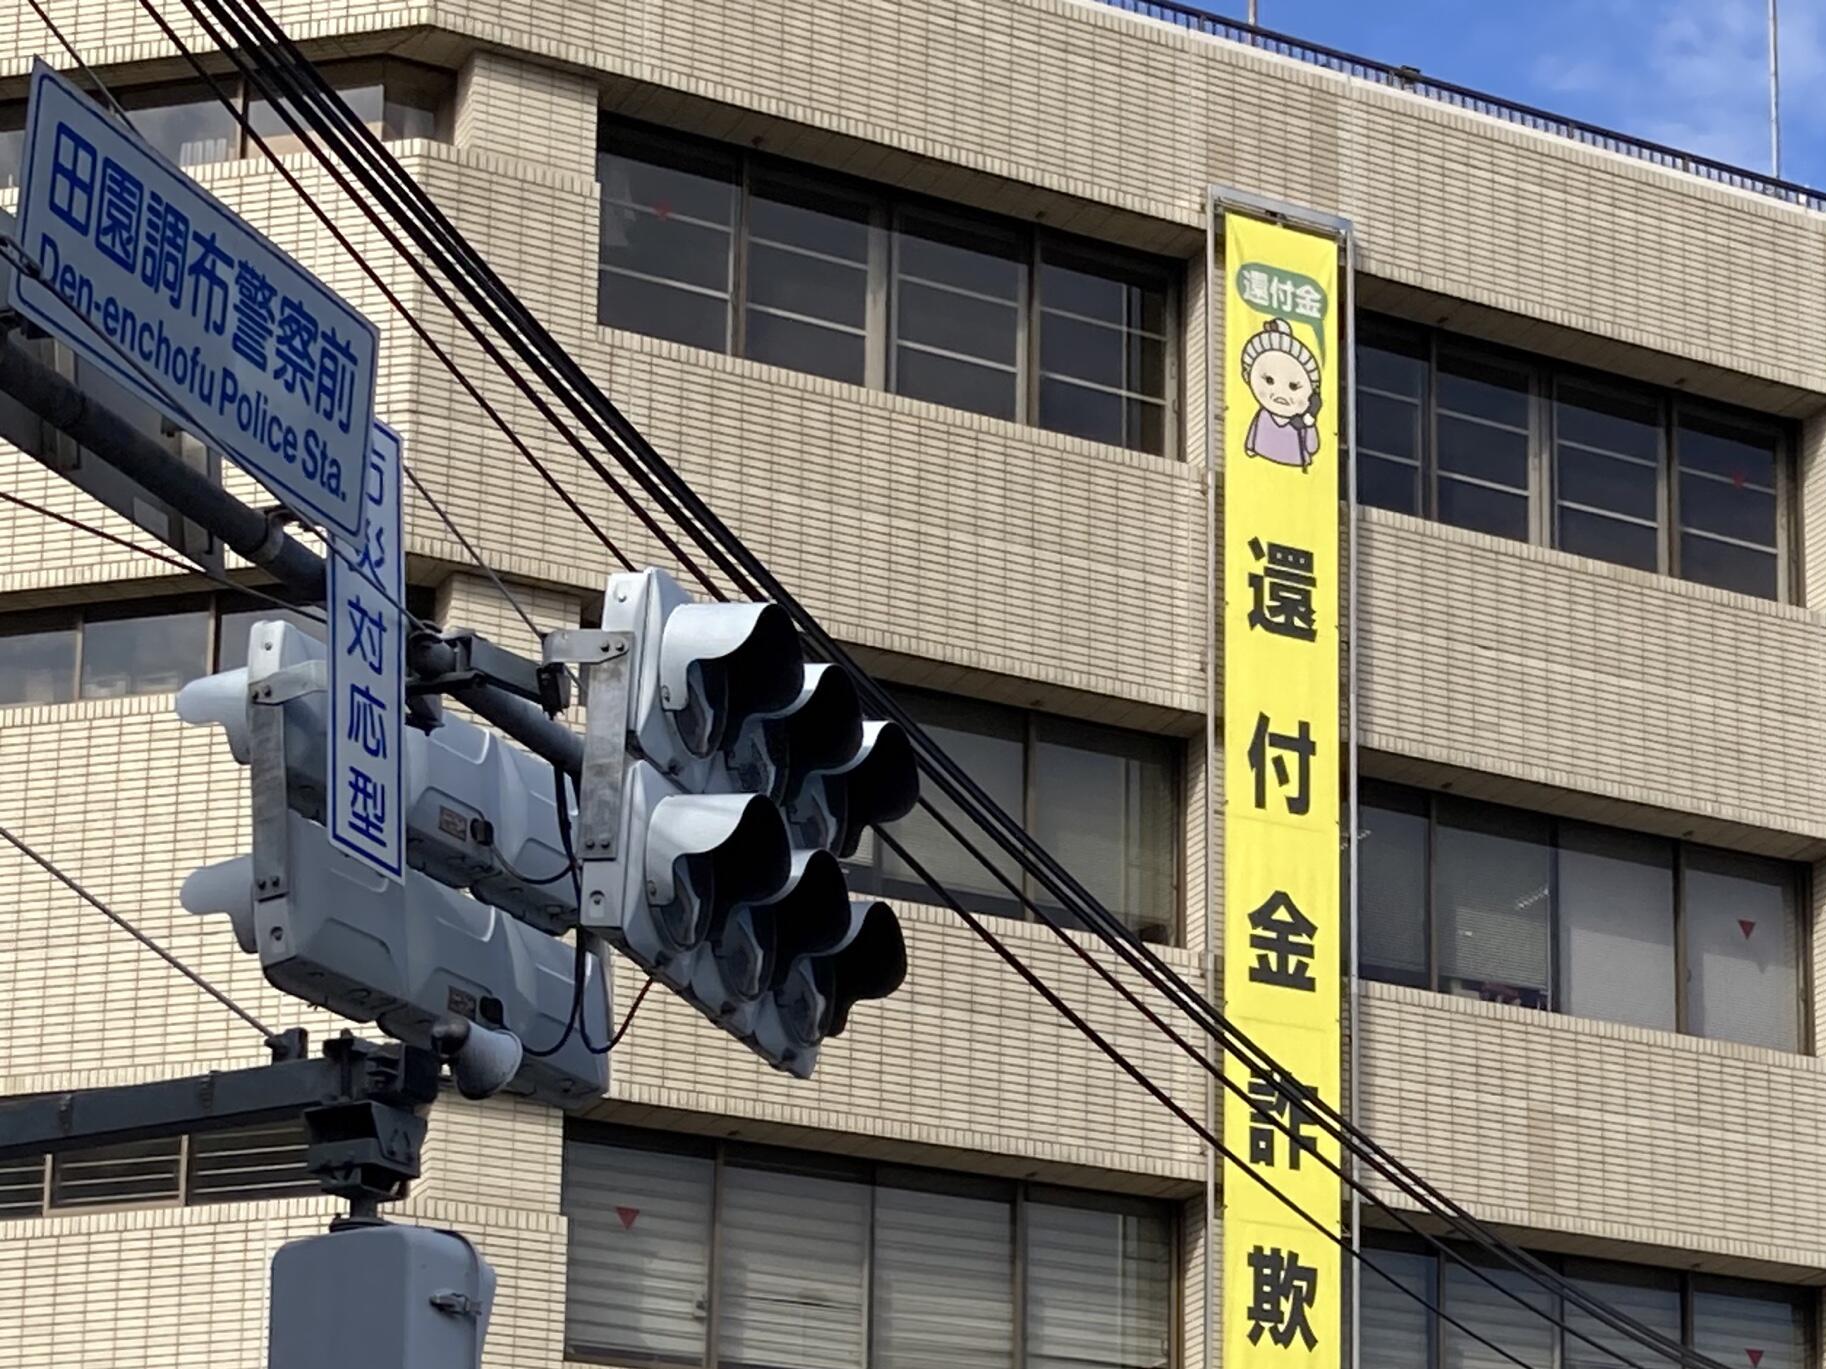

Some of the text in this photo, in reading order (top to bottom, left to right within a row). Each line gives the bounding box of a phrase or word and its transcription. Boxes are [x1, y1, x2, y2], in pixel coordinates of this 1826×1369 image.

[38, 232, 347, 502] Den-enchofu Police Sta.
[48, 121, 358, 436] 田園調布警察前
[1242, 269, 1323, 319] 還付金
